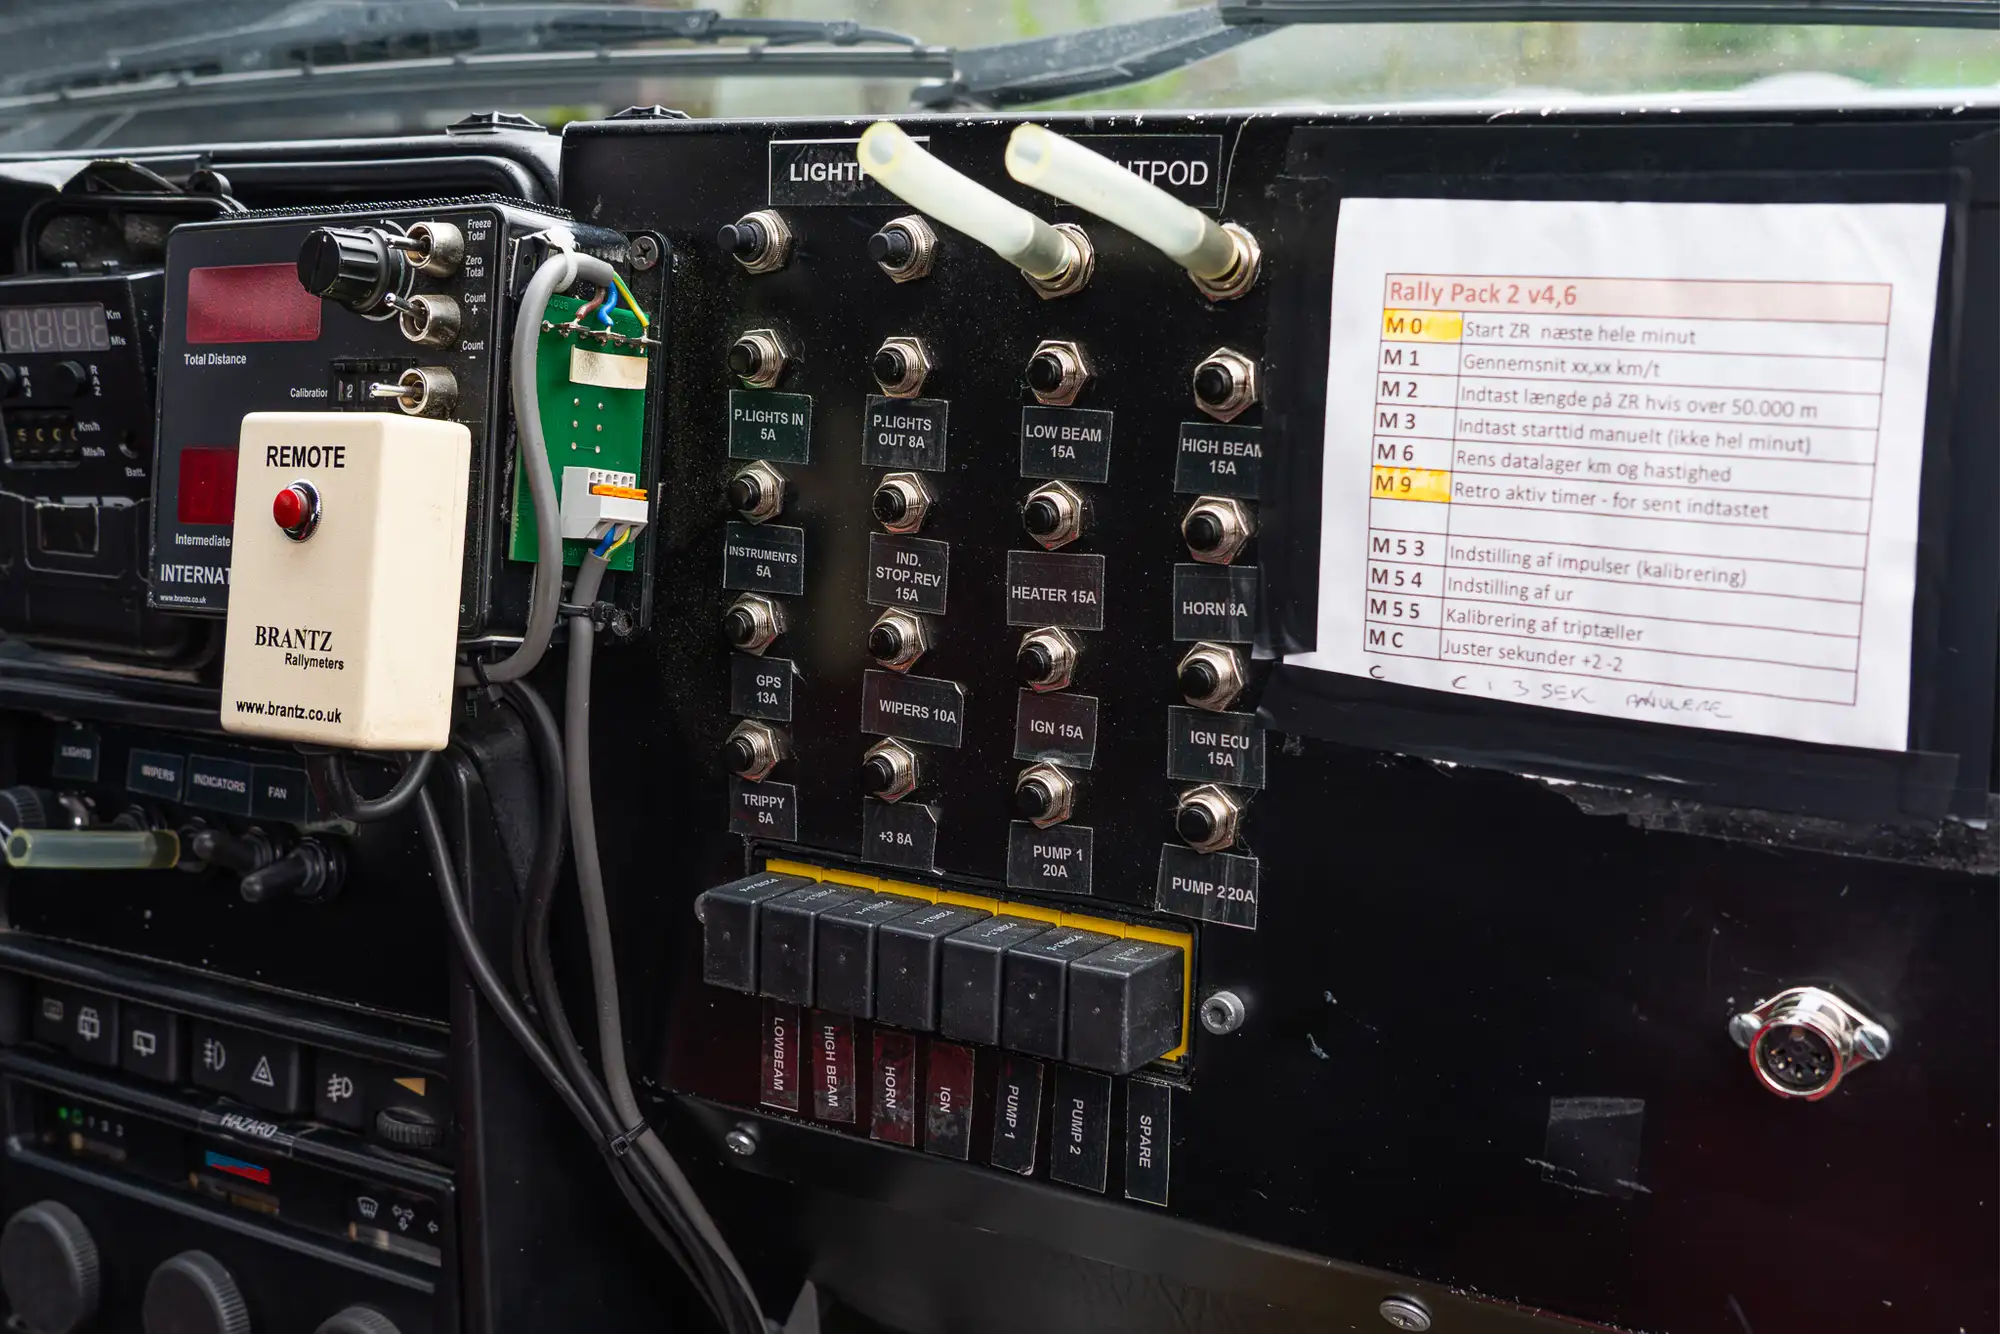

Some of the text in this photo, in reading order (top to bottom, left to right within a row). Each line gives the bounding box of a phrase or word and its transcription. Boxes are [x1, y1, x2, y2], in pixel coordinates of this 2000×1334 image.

[467, 218, 492, 229] Freeze
[467, 230, 486, 241] Total
[465, 255, 483, 266] Zero
[465, 266, 484, 277] Total
[464, 292, 487, 303] Count
[1389, 281, 1578, 309] Rally Pack 2 v4,6
[106, 309, 121, 320] Km
[1386, 316, 1423, 335] M 0
[1465, 320, 1696, 346] Start ZR næste hele minut
[462, 340, 484, 351] Count
[183, 352, 247, 366] Total Distance
[1383, 348, 1420, 367] M 1
[1463, 352, 1660, 379] Gennemsnit xx,xx km/t
[1381, 380, 1418, 398] M 2
[1460, 384, 1819, 419] Indtast længde på ZR hvis over 50.000 m
[734, 408, 804, 426] P.LIGHTS IN
[873, 414, 932, 432] P.LIGHTS
[1379, 412, 1416, 430] M 3
[760, 427, 777, 441] 5A
[878, 432, 926, 449] OUT 8A
[1025, 424, 1102, 443] LOW BEAM
[1458, 418, 1812, 457] Indtast starttid manuelt (ikke hel minut)
[1050, 445, 1075, 460] 15A
[1182, 438, 1219, 455] HIGH
[1376, 443, 1414, 461] M 6
[266, 445, 346, 468] REMOTE
[1209, 460, 1237, 476] 15A
[1456, 450, 1732, 485] Rens datalager km og hastighed
[1375, 474, 1412, 493] M 9
[1455, 482, 1770, 520] Retro aktiv timer for sent indtastet
[175, 532, 231, 547] Intermediate
[729, 545, 798, 564] INSTRUMENTS
[896, 551, 922, 568] IND.
[756, 565, 772, 579] 5A
[1449, 545, 1747, 589] Indstilling af impulser (kalibrering)
[875, 565, 942, 588] STOP.REV
[895, 588, 919, 602] 15A
[1011, 586, 1097, 605] HEATER 15A
[1447, 576, 1574, 602] Indstilling af ur
[160, 594, 207, 604] www.brantz.co.uk
[1182, 601, 1248, 618] HORN 8A
[1445, 607, 1644, 642] Kalibrering af triptæller
[254, 625, 333, 652] BRANTZ
[1369, 628, 1386, 646] M
[284, 652, 345, 671] Rallymeters
[1443, 640, 1623, 673] Juster sekunder +2 -2
[756, 674, 782, 689] GPS
[756, 691, 778, 705] 13A
[235, 700, 342, 723] www.brantz.co.uk
[879, 699, 957, 724] WIPERS 10A
[1030, 718, 1084, 740] IGN 15A
[1190, 730, 1250, 750] IGN ECU
[1207, 751, 1235, 767] 15A
[194, 772, 246, 794] INDICATORS
[268, 786, 287, 800] FAN
[742, 793, 785, 809] TRIPPY
[758, 811, 774, 825] 5A
[878, 830, 914, 847] +3 8A
[1032, 844, 1083, 861] PUMP 1
[1042, 863, 1068, 878] 20A
[1172, 876, 1214, 896] PUMP
[773, 1016, 785, 1092] LOWBEAM
[823, 1024, 839, 1108] HIGH BEAM
[884, 1065, 896, 1109] HORN
[939, 1085, 951, 1114] IGN
[1004, 1084, 1020, 1140] PUMP 1
[1069, 1097, 1085, 1156] PUMP 2
[1138, 1115, 1153, 1169] SPARE
